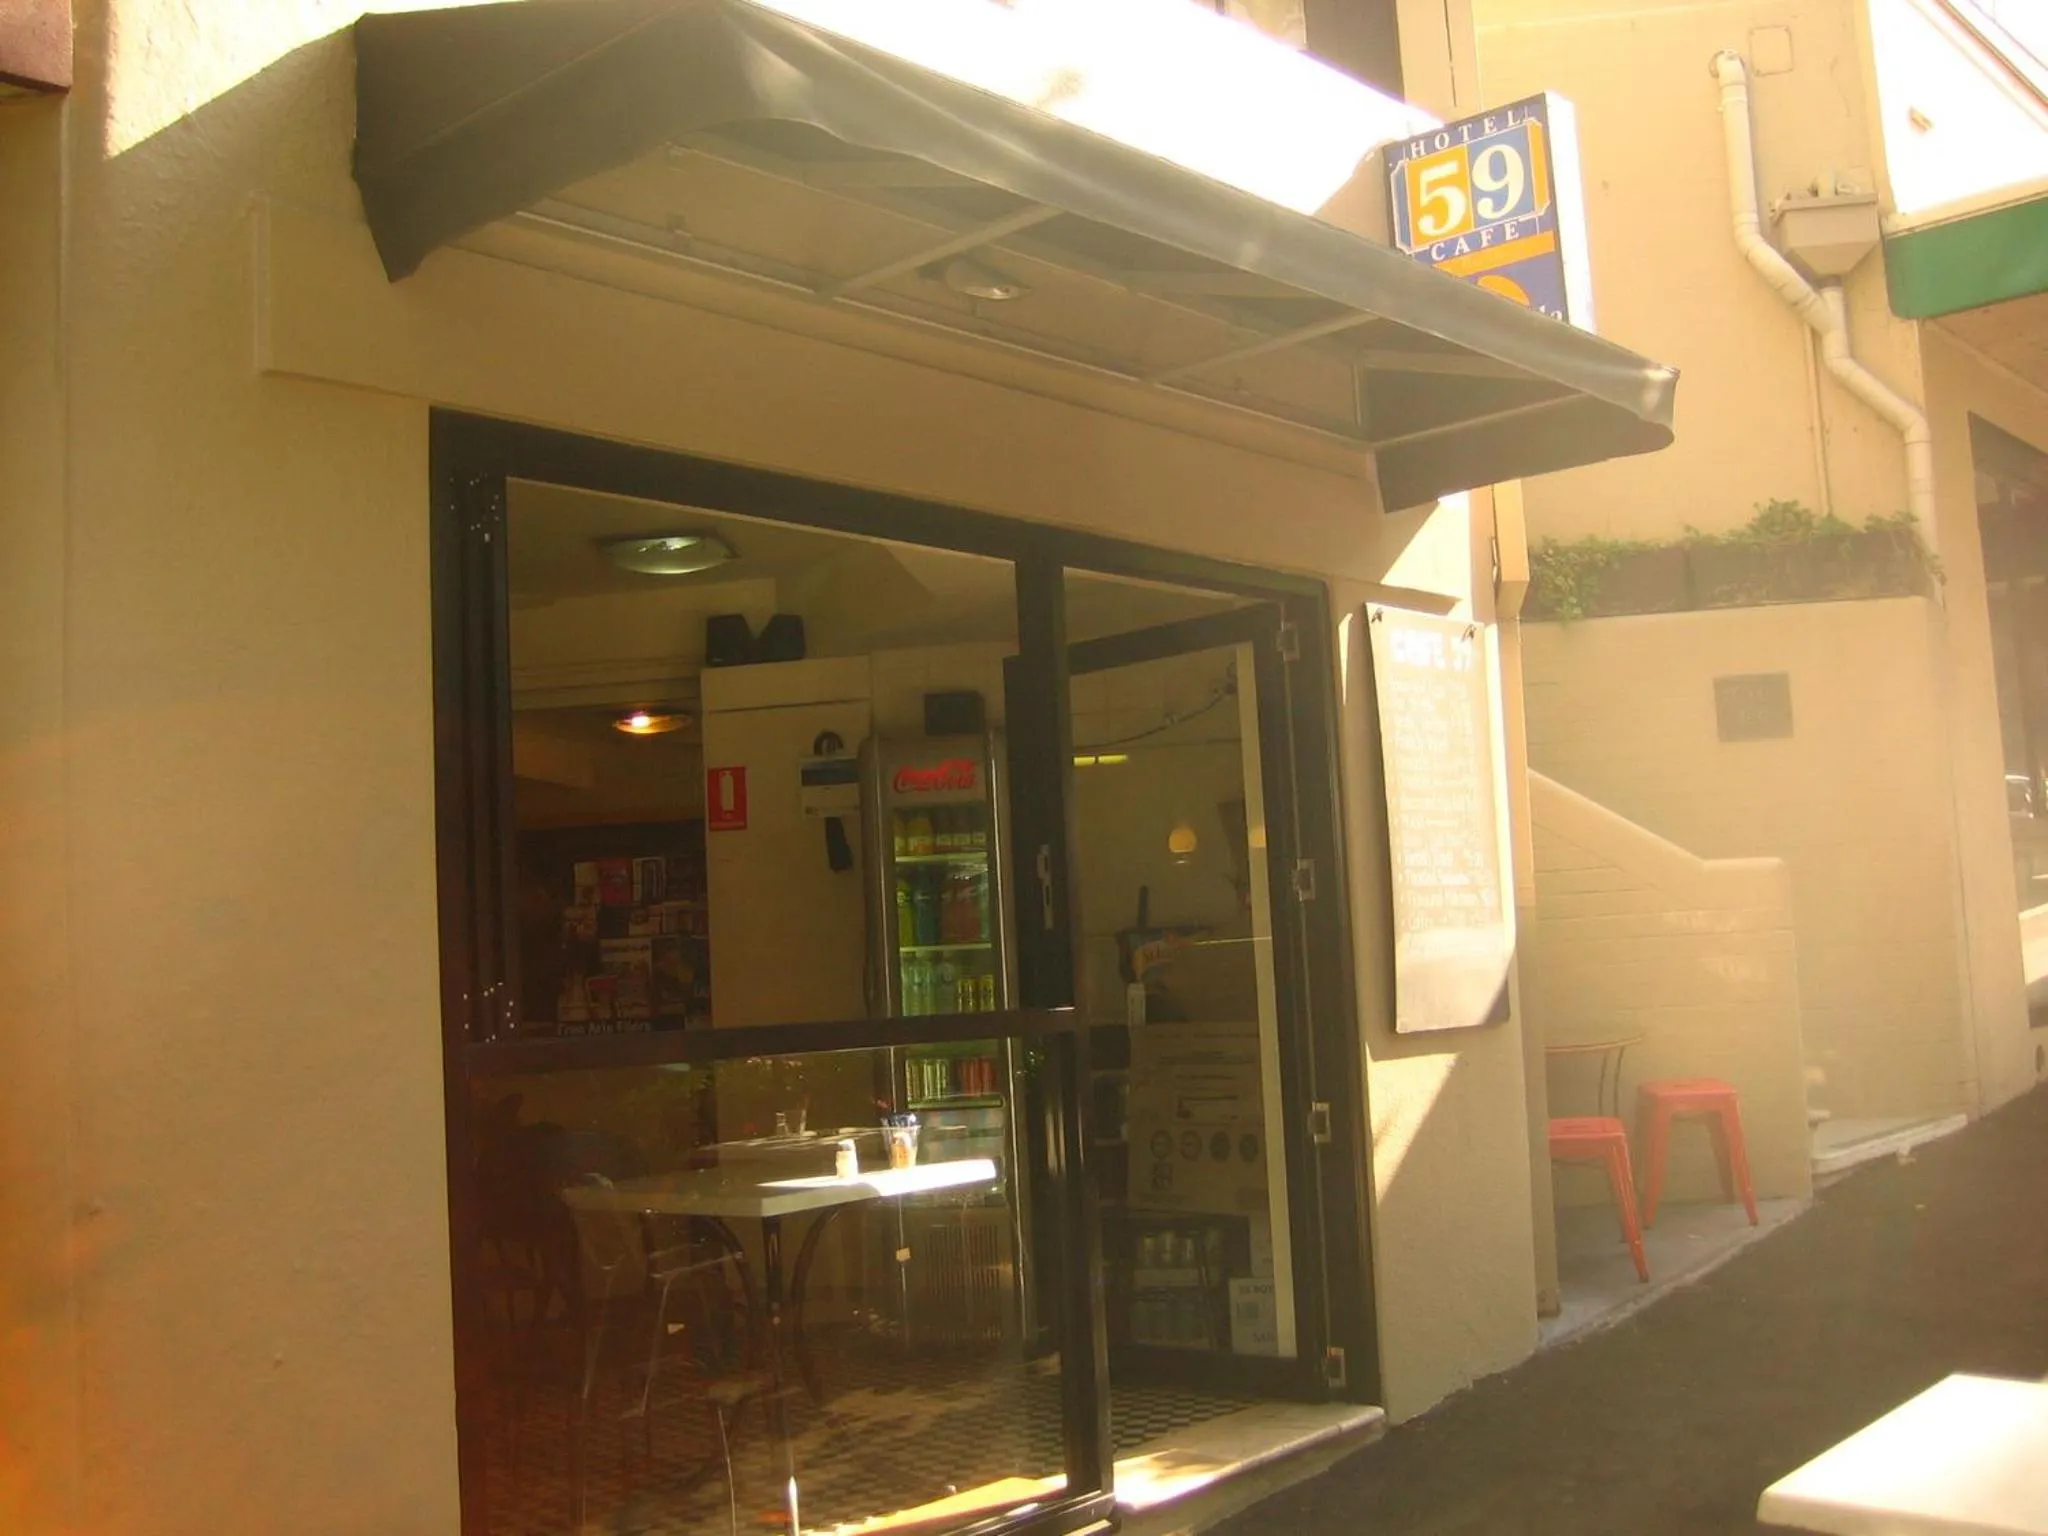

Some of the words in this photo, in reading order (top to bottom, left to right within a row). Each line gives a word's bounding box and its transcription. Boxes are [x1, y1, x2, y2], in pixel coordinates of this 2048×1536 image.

[1410, 110, 1521, 157] HOTEL
[1417, 144, 1525, 237] 59
[1430, 220, 1520, 261] CAFE
